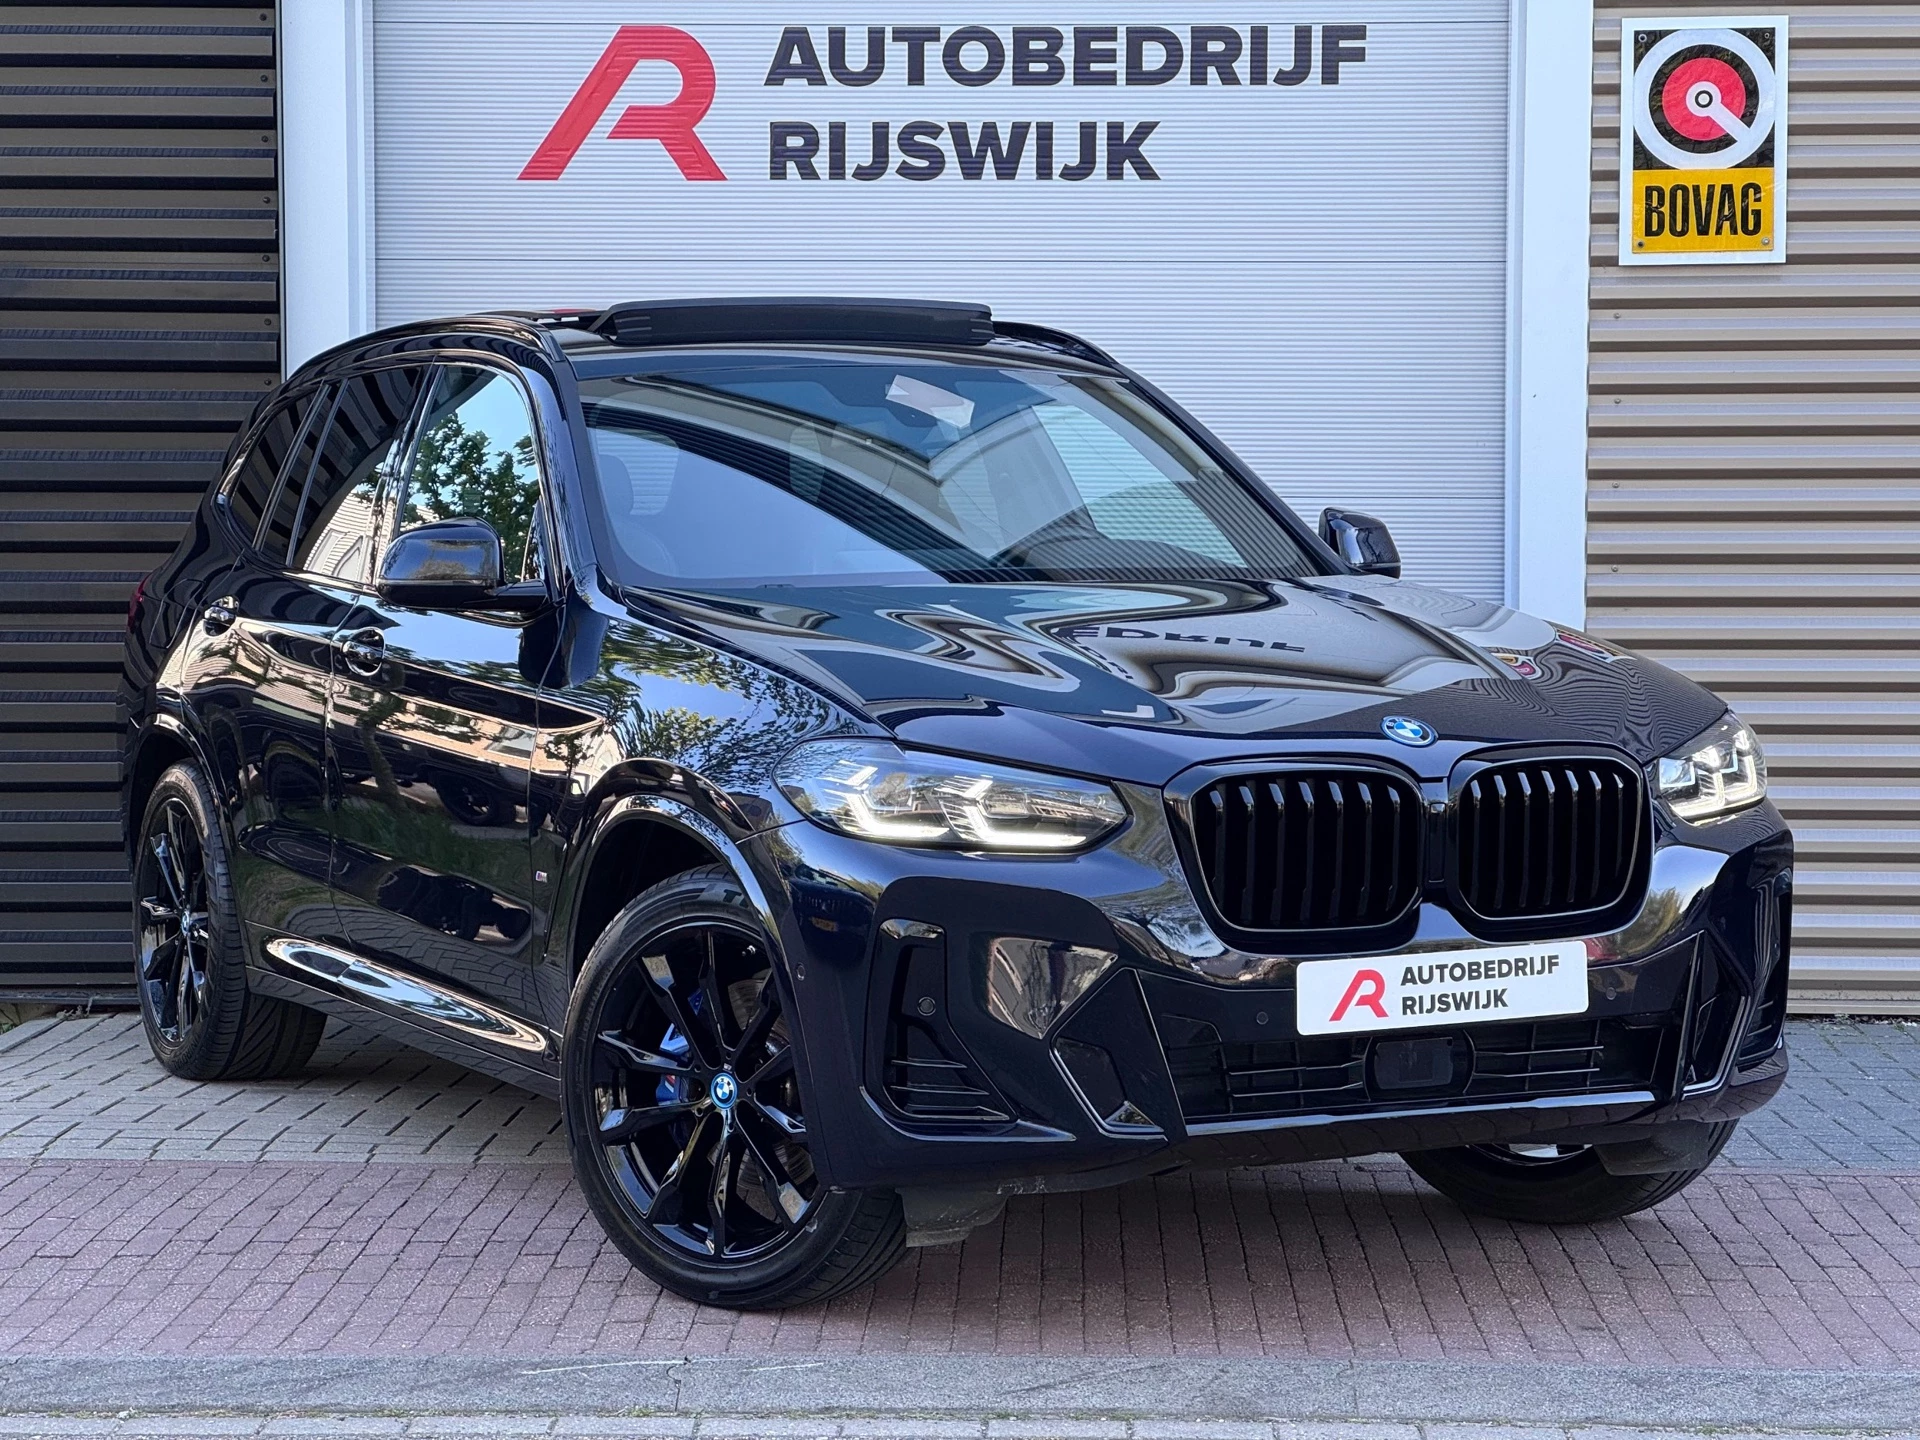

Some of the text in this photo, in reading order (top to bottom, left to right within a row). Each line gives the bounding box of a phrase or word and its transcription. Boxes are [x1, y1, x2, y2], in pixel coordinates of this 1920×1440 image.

[764, 25, 1366, 87] AUTOBEDRIJF
[770, 121, 1161, 181] RIJSWIJK
[1645, 183, 1761, 237] BOVAG
[1400, 955, 1560, 986] AUTOBEDRIJF
[1402, 988, 1508, 1016] RIJSWIJK
